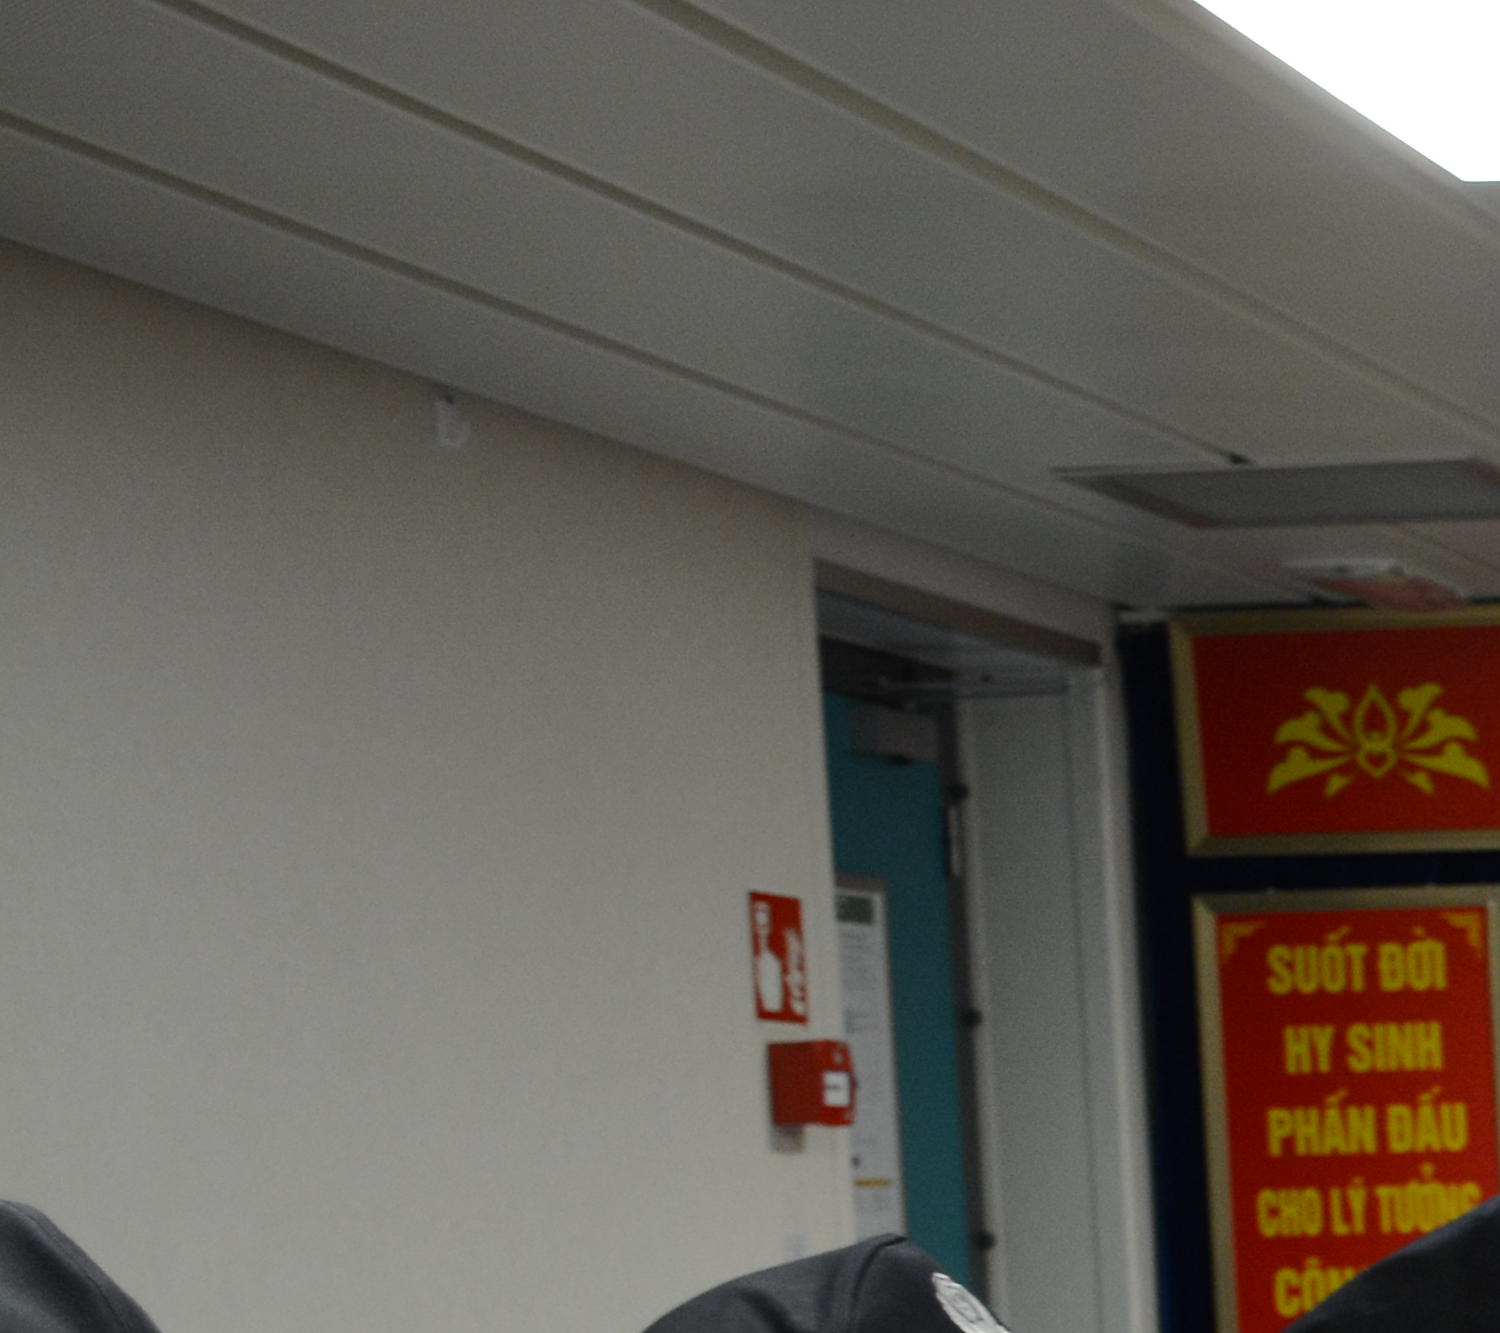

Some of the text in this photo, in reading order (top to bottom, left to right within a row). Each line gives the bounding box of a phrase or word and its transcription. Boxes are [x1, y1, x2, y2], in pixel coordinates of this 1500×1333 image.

[1266, 925, 1369, 995] SUỐT
[1283, 1021, 1444, 1075] HY SINH
[1266, 1087, 1377, 1158] PHẤN
[1256, 1186, 1324, 1238] CHO
